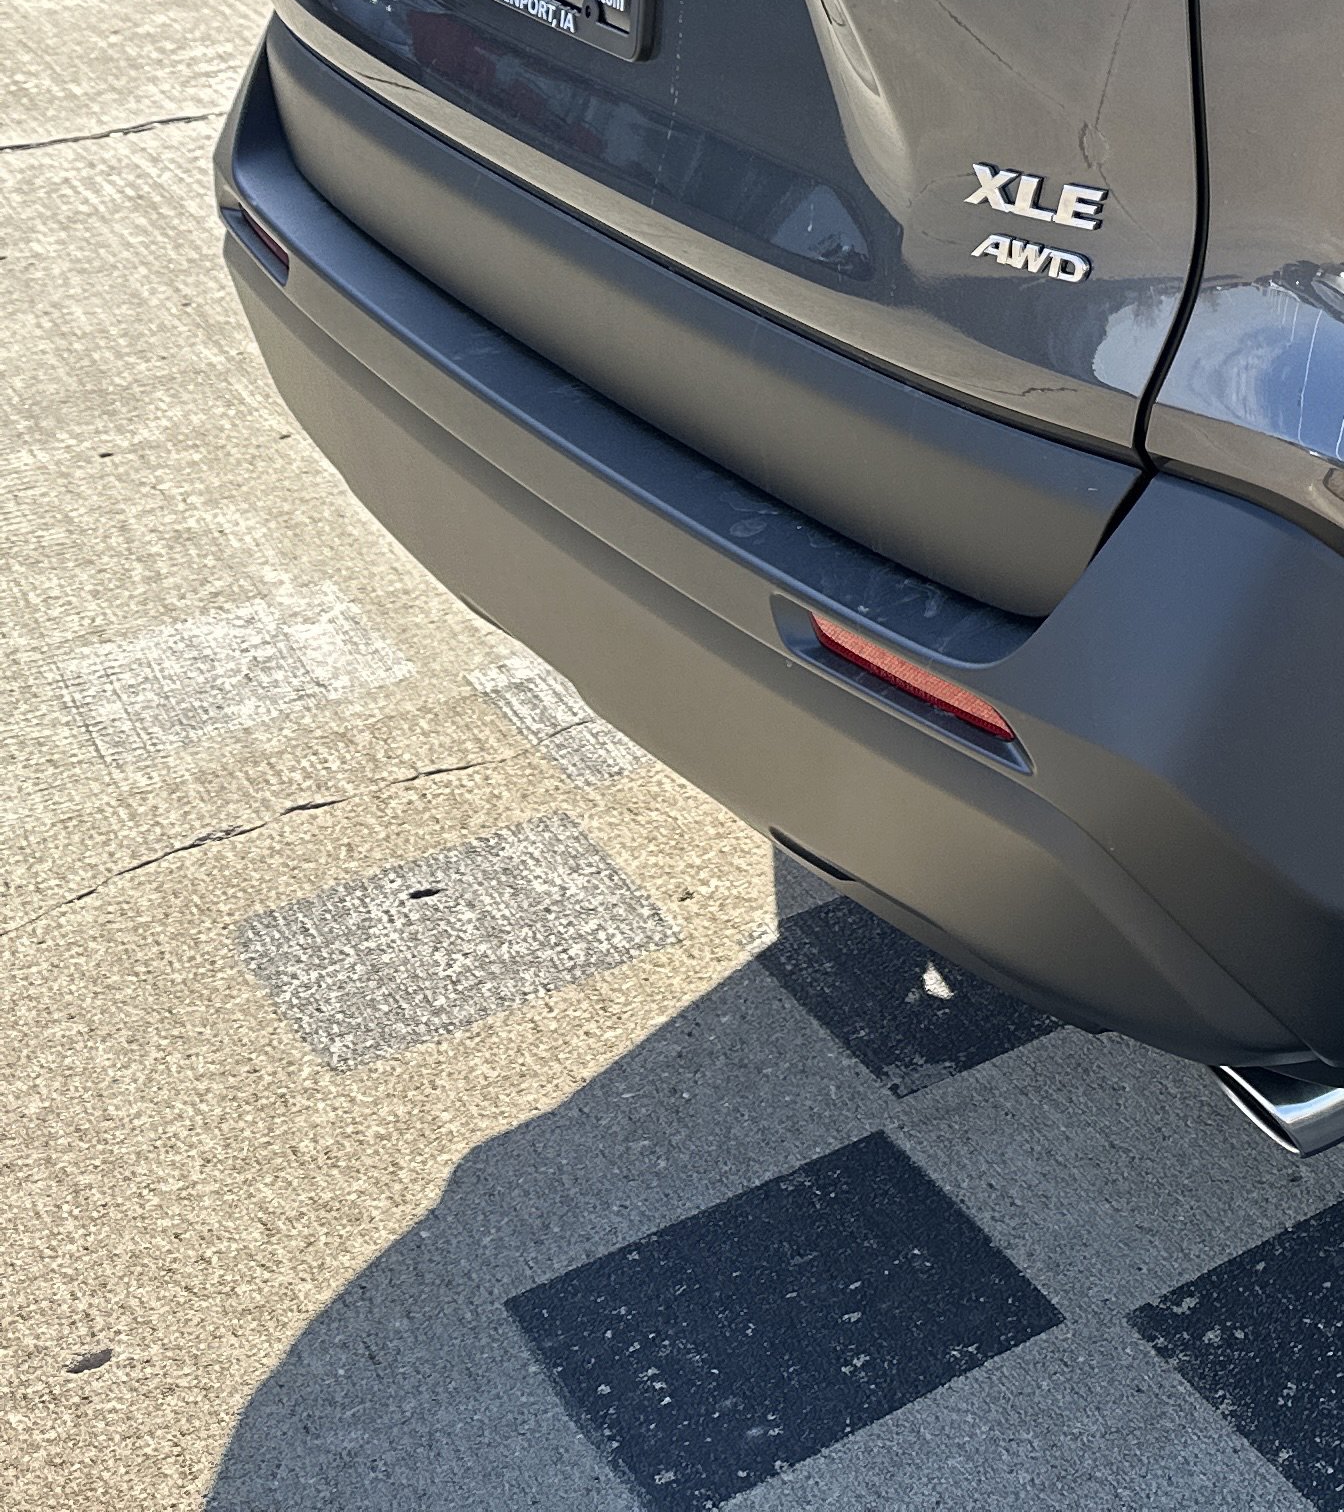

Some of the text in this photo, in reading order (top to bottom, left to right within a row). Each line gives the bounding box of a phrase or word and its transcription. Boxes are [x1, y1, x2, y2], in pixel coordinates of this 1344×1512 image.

[559, 9, 576, 34] IA
[963, 162, 1109, 231] XLE
[970, 233, 1092, 283] AWD
